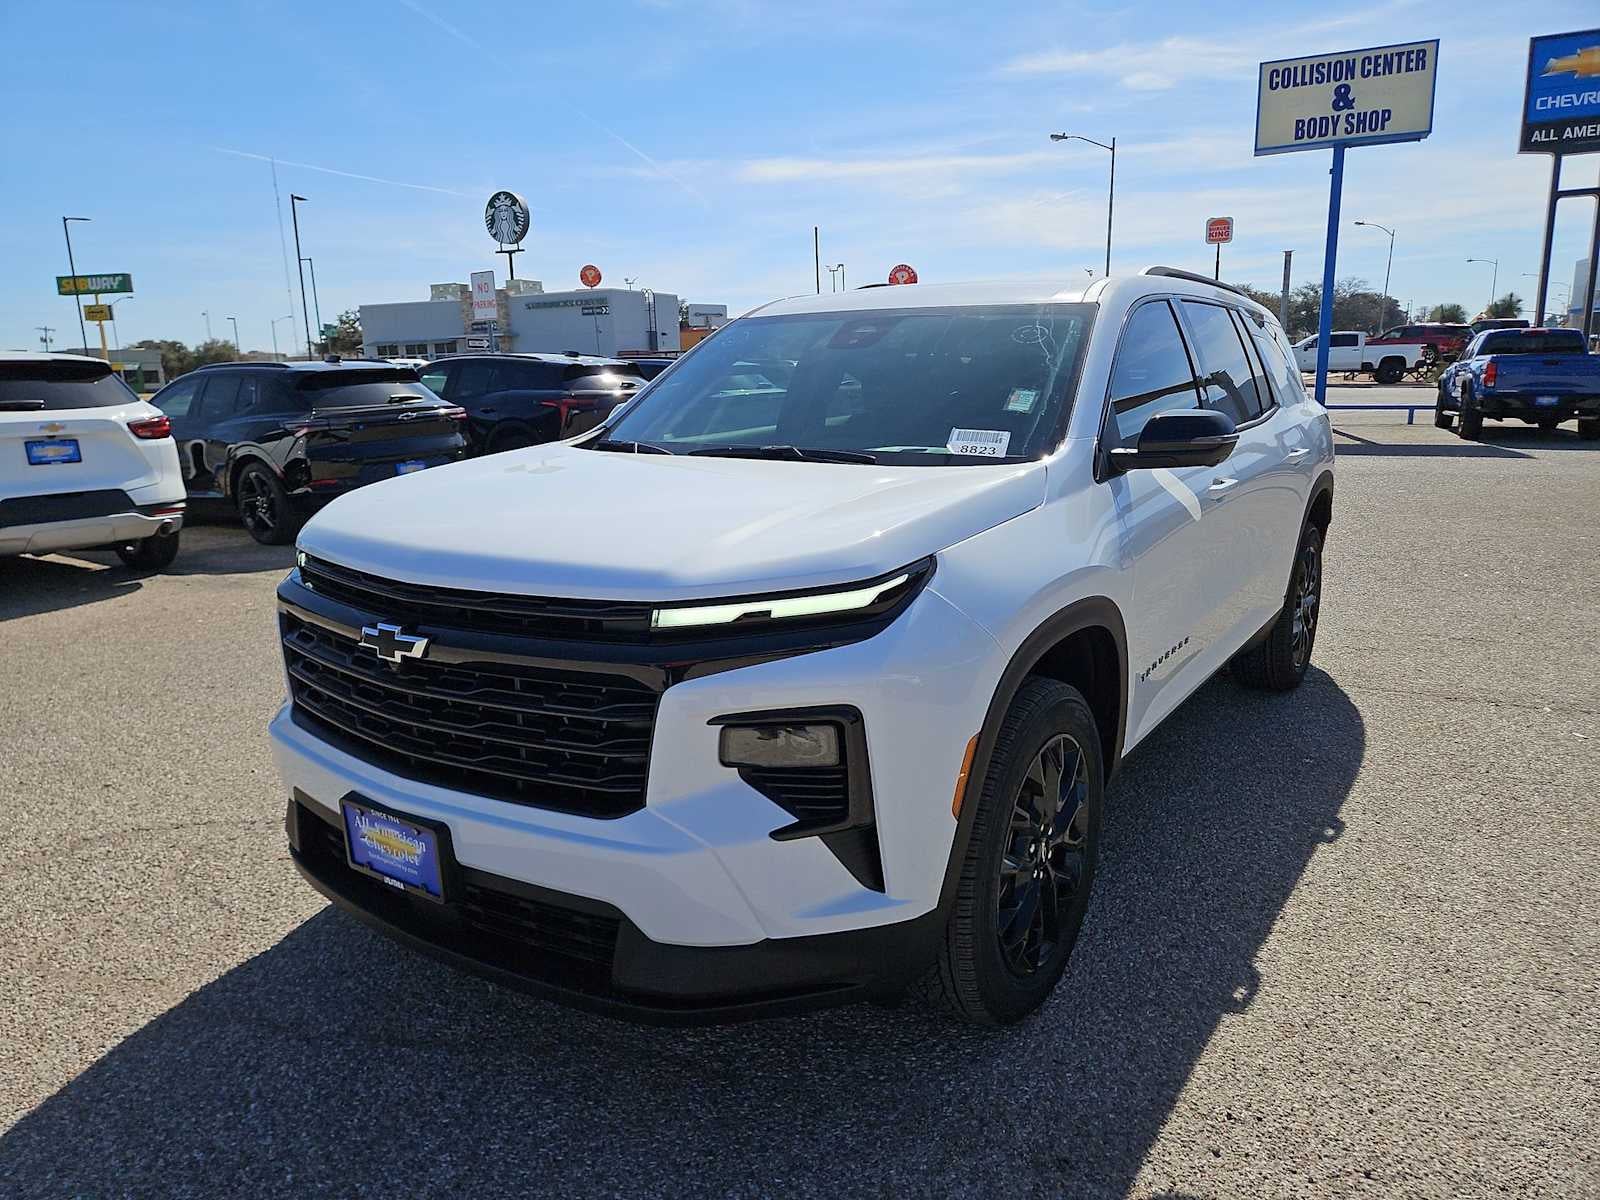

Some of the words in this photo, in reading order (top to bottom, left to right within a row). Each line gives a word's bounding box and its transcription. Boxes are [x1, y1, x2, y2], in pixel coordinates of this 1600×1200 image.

[1269, 59, 1356, 91] COLLISION
[1360, 48, 1428, 79] CENTER
[1331, 83, 1356, 112] &
[1294, 114, 1341, 141] BODY
[1344, 108, 1392, 135] SHOP
[1531, 128, 1558, 142] ALL
[1208, 230, 1230, 238] KING
[477, 282, 489, 294] NO
[472, 300, 497, 310] PARKING
[960, 444, 997, 455] 8823
[1140, 636, 1190, 682] TRAVERSE
[354, 815, 369, 831] All
